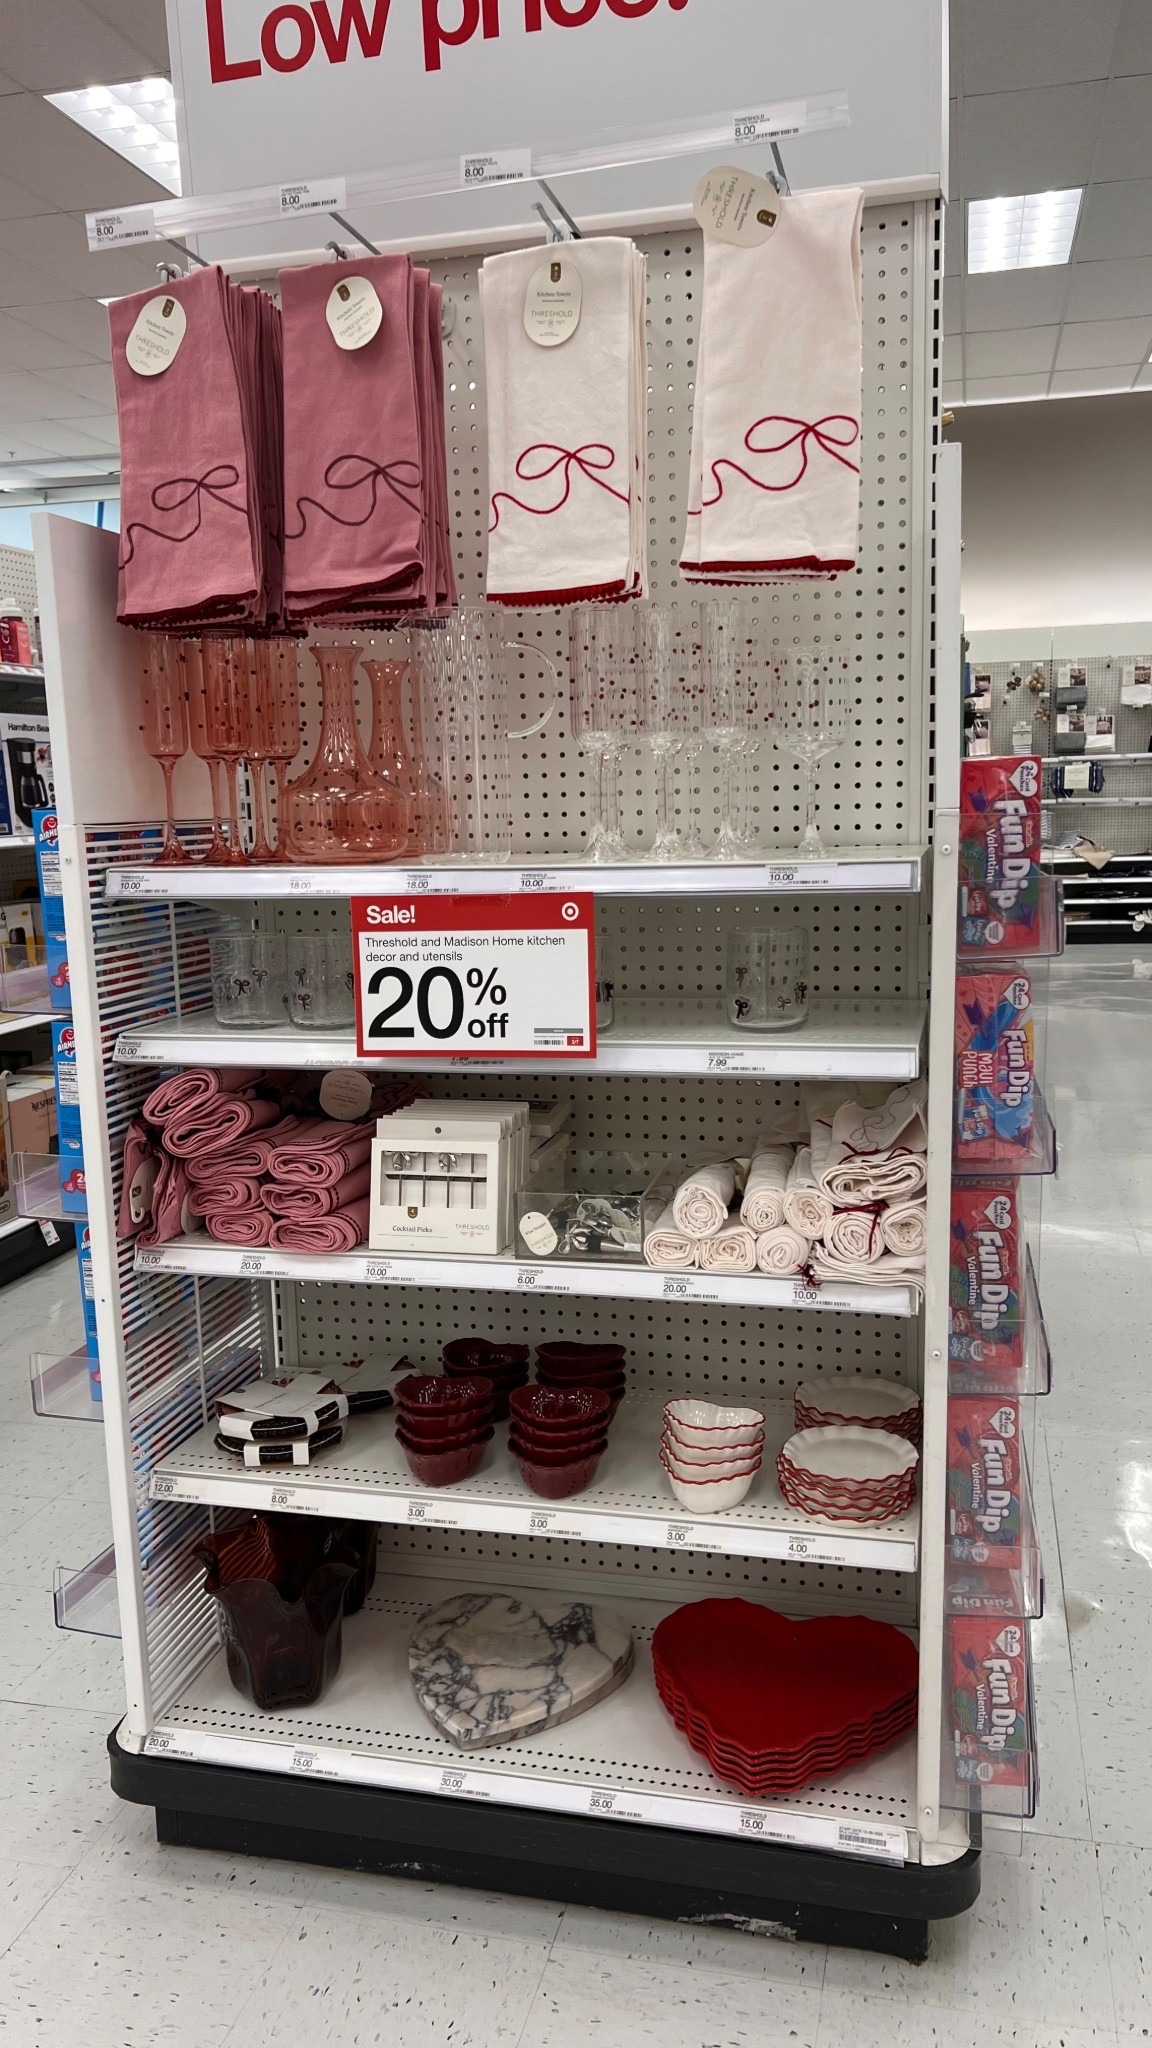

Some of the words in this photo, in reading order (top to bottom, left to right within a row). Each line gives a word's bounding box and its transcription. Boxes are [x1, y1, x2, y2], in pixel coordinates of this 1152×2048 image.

[205, 0, 390, 83] Low
[421, 0, 688, 71] pr.
[735, 125, 756, 137] 8.00
[465, 167, 484, 178] 8.00
[282, 195, 299, 206] 8.00
[716, 176, 738, 228] THRESHOLD
[96, 226, 113, 236] 8.00
[340, 307, 375, 337] THRESHOLD
[135, 334, 170, 356] THRESHOLD
[8, 723, 36, 731] Hamilton
[1025, 766, 1033, 777] 24
[994, 800, 1027, 854] Fun
[986, 829, 998, 884] Valentine
[990, 858, 1031, 909] Dip
[366, 905, 416, 924] Sale!
[365, 937, 418, 948] Threshold
[421, 936, 441, 947] and
[444, 936, 489, 947] Madison
[492, 936, 524, 946] Home
[527, 936, 565, 946] kitchen
[366, 952, 396, 962] decor
[400, 952, 419, 961] and
[423, 951, 463, 961] utensils
[1017, 983, 1025, 993] 24
[467, 1013, 508, 1038] off
[1002, 1029, 1027, 1068] Fun
[1000, 1071, 1030, 1107] Dip
[32, 1096, 56, 1111] NESPRES
[1000, 1201, 1007, 1212] 24
[392, 1225, 415, 1233] Cocktail
[141, 1256, 160, 1264] 10.00
[973, 1231, 1004, 1280] Fun
[241, 1262, 262, 1270] 20.00
[366, 1268, 386, 1276] 10.00
[518, 1276, 535, 1284] 6.00
[967, 1256, 980, 1305] Valentine
[663, 1284, 686, 1293] 20.00
[793, 1291, 817, 1299] 10.00
[974, 1285, 1008, 1330] Dip
[1004, 1410, 1011, 1421] 24
[978, 1439, 1008, 1486] Fun
[154, 1484, 174, 1492] 12.00
[971, 1463, 984, 1509] Valentine
[271, 1495, 287, 1504] 8.00
[408, 1509, 425, 1517] 3.00
[975, 1490, 1010, 1533] Dip
[530, 1519, 547, 1528] 3.00
[667, 1532, 685, 1541] 3.00
[789, 1544, 807, 1553] 4.00
[1009, 1629, 1017, 1640] 24
[983, 1659, 1012, 1704] Fun
[976, 1684, 988, 1730] Valentine
[980, 1708, 1016, 1751] Dip
[149, 1738, 169, 1747] 20.00
[292, 1758, 313, 1767] 15.00
[441, 1778, 462, 1788] 30.00
[590, 1799, 612, 1808] 35.00
[740, 1819, 763, 1829] 15.00
